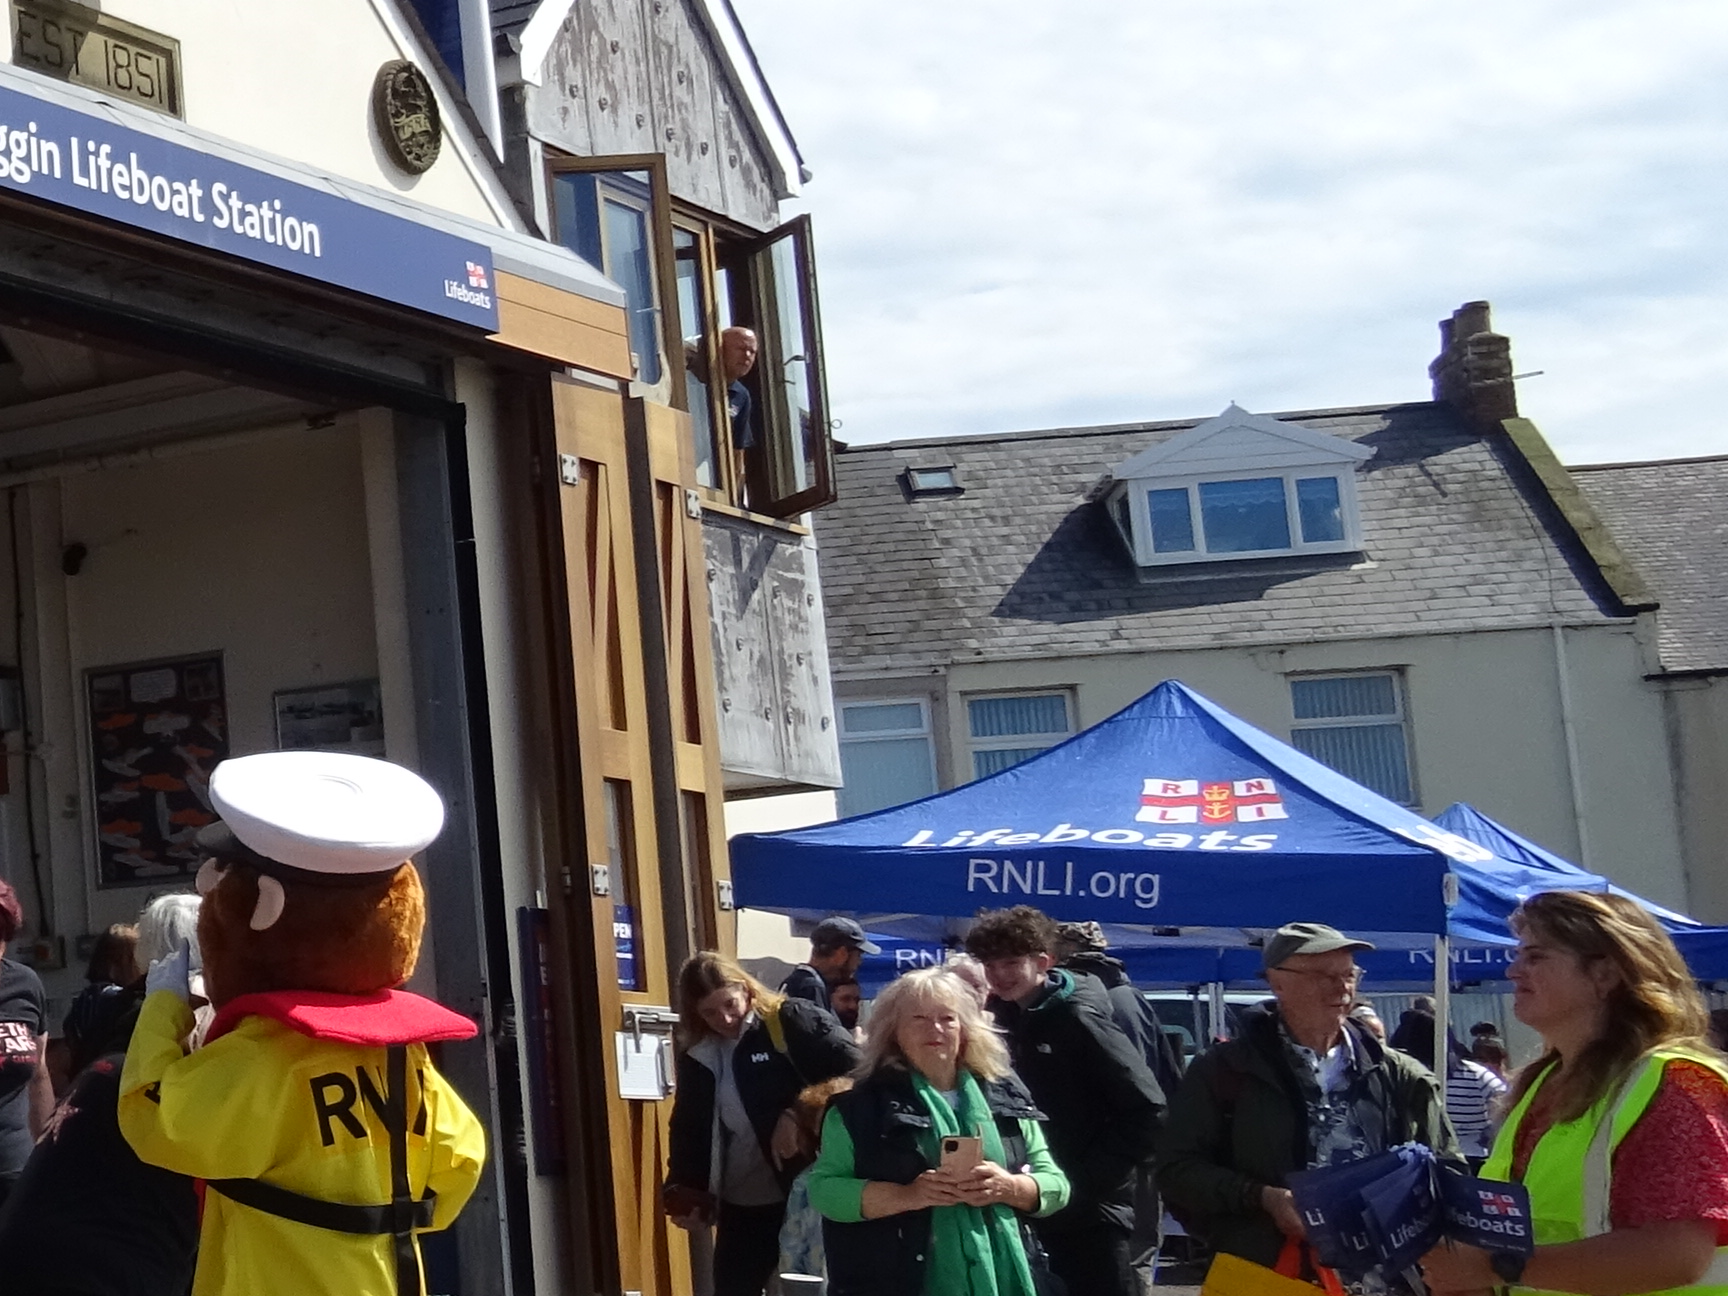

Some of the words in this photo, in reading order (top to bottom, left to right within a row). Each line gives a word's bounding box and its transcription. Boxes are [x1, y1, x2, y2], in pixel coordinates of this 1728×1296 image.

[18, 9, 84, 76] EST
[103, 39, 163, 104] 1851
[70, 136, 206, 223] Lifeboat
[211, 182, 322, 258] Station
[444, 279, 492, 309] Lifeboats
[900, 823, 1279, 852] Lifeboats
[966, 857, 1160, 909] RNLI.org
